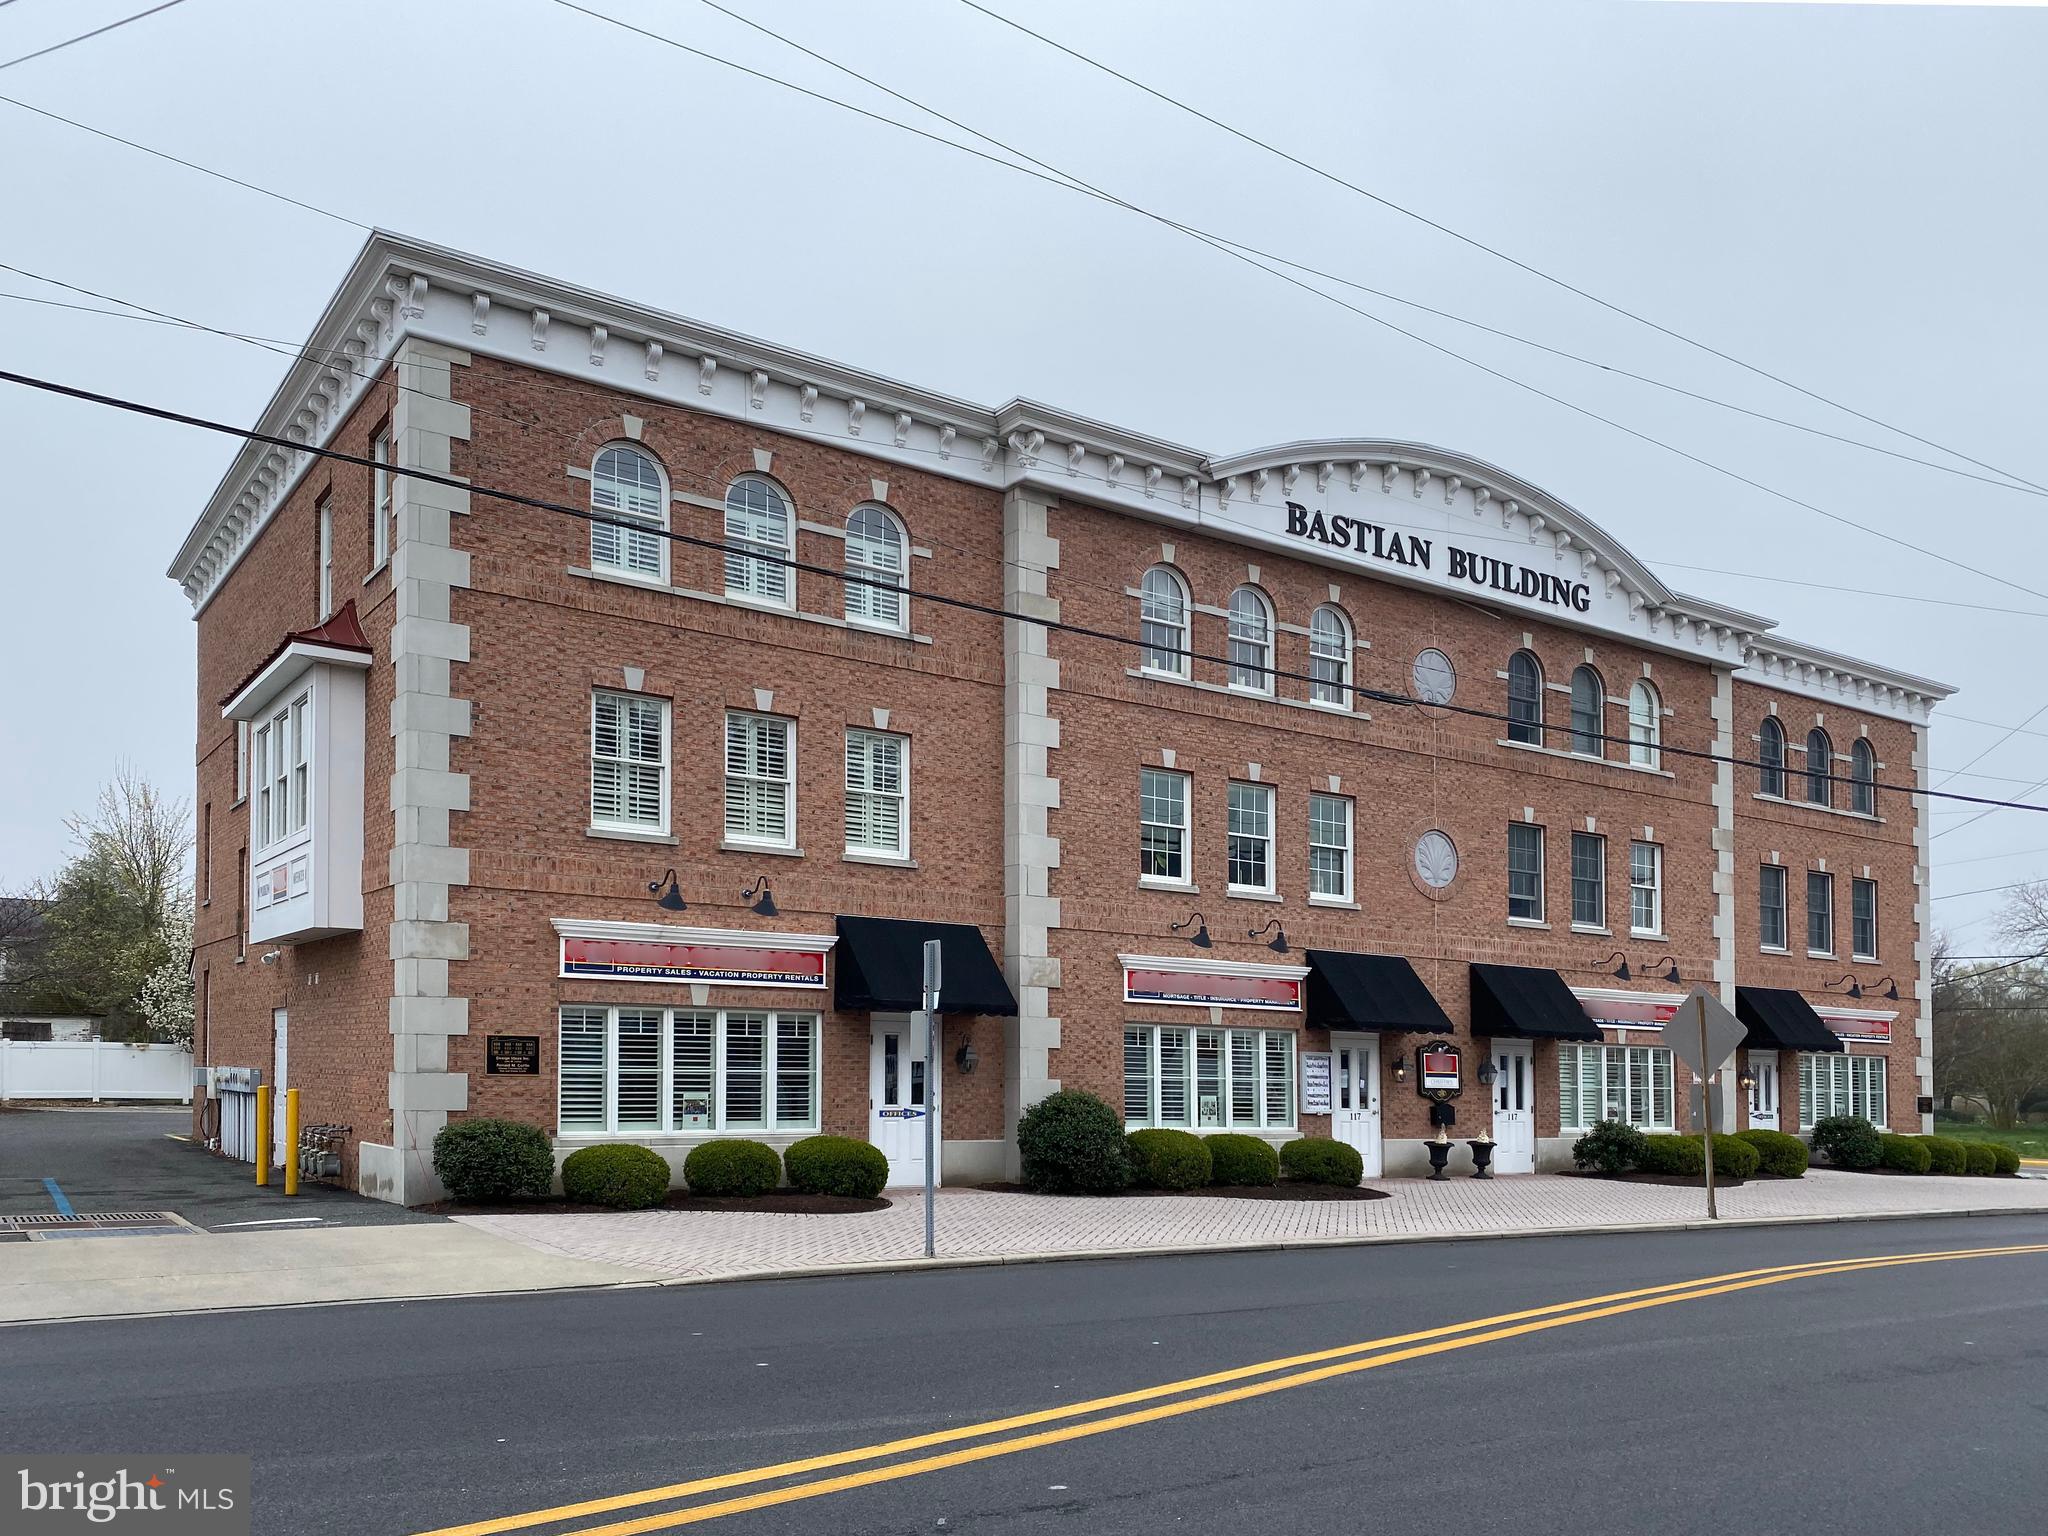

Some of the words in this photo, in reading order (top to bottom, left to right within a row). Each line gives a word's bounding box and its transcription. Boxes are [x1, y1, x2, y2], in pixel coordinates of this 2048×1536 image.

[1285, 501, 1432, 570] BASTIAN
[1448, 546, 1591, 612] BUILDING
[616, 966, 663, 976] PROPERTY
[665, 968, 692, 977] SALES
[698, 970, 739, 979] VACATION
[741, 972, 783, 981] PROPERTY
[785, 974, 819, 982] RENTALS
[1349, 1112, 1361, 1121] 117
[1507, 1113, 1518, 1121] 117
